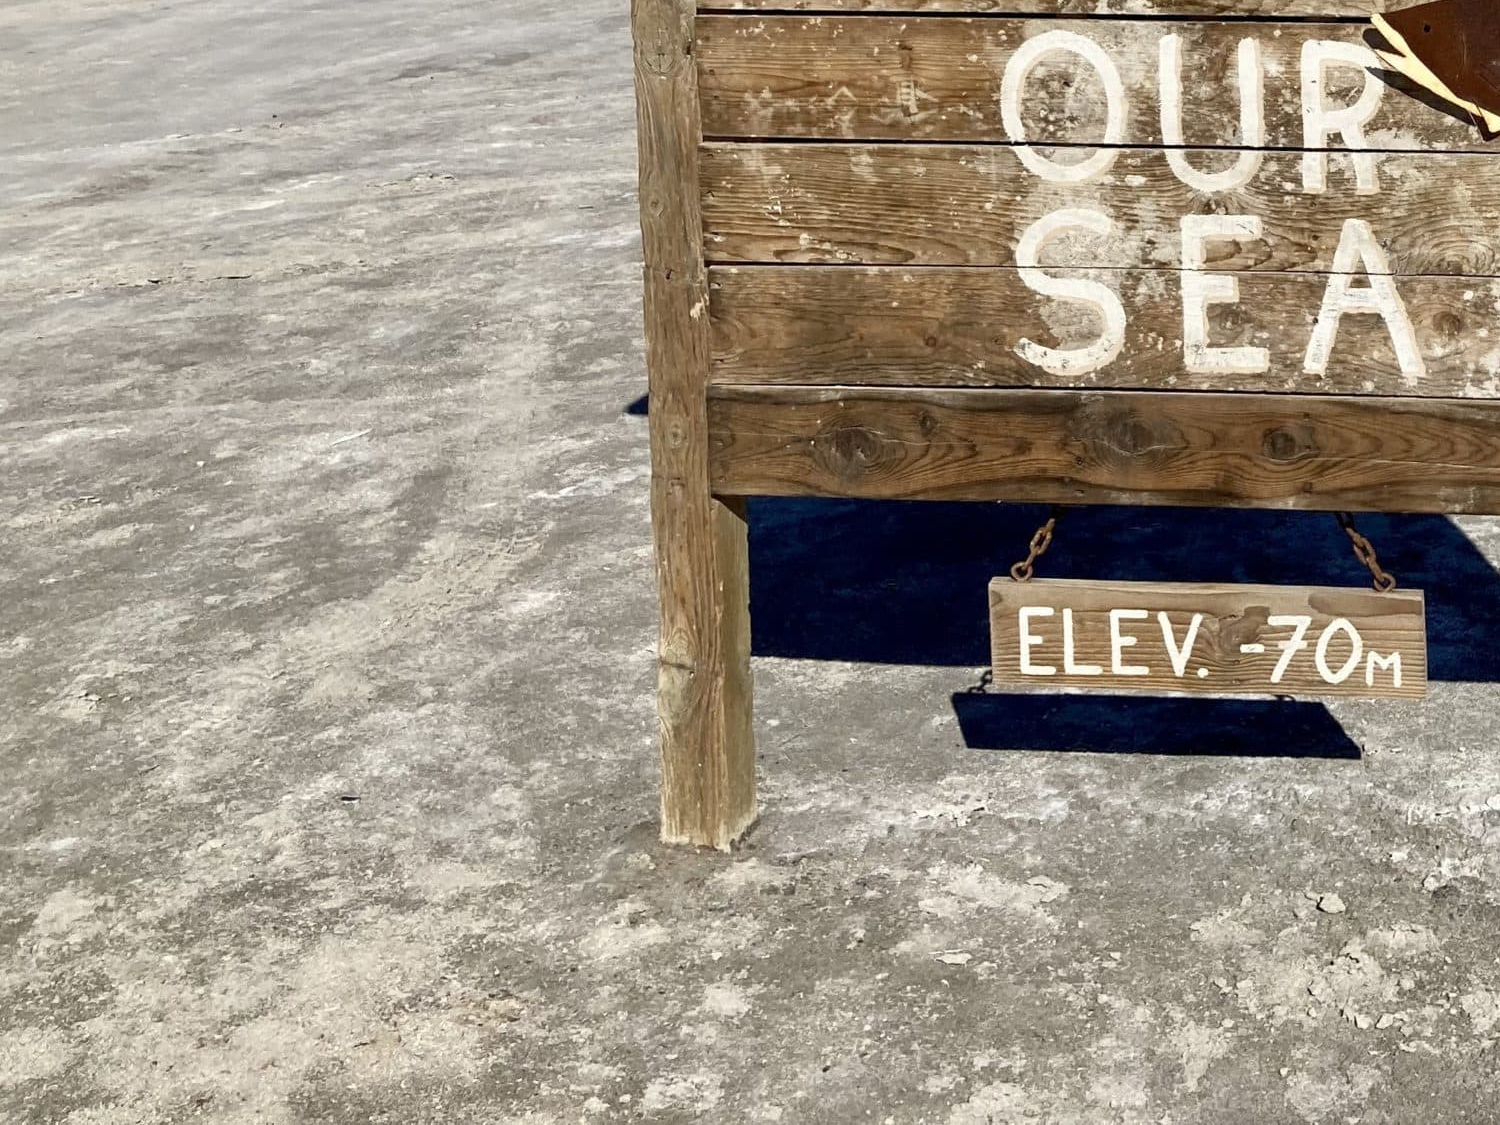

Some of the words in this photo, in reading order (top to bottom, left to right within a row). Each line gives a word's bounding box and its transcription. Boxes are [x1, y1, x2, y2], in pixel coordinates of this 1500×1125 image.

[1000, 29, 1385, 195] OUR
[1013, 208, 1426, 377] SEA
[1018, 606, 1209, 678] ELEV.
